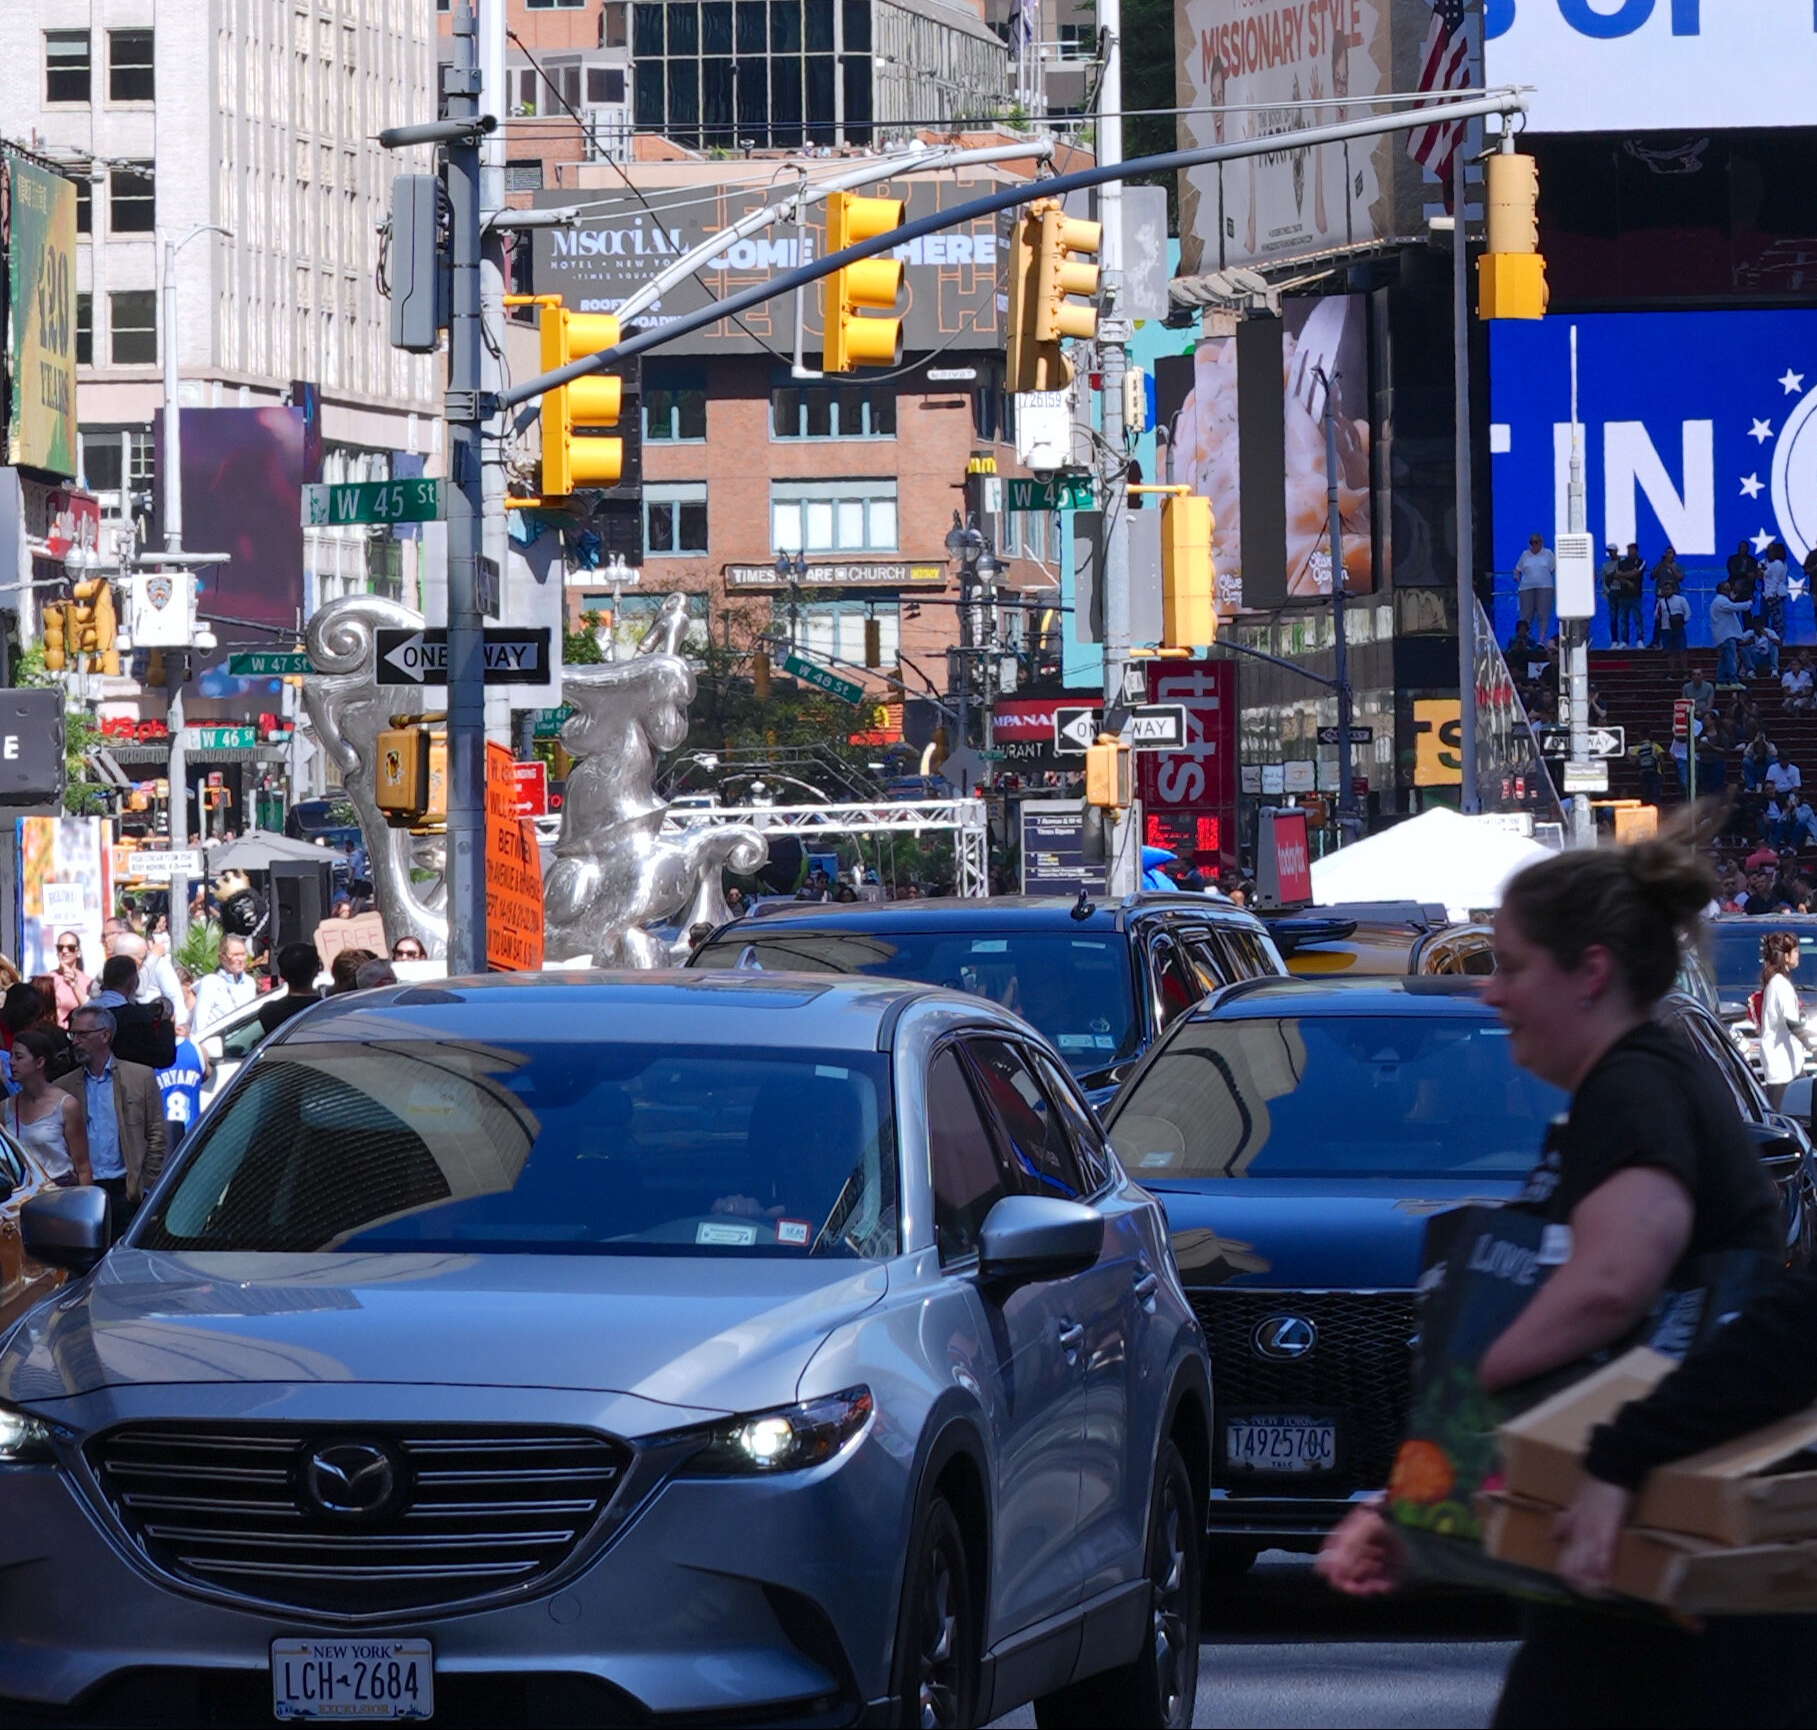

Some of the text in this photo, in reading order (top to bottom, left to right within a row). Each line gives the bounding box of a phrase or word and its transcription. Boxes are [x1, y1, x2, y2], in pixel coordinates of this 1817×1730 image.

[1201, 1, 1304, 84] MISSIONARY
[891, 233, 997, 266] HERE
[551, 259, 645, 271] HOTEL NEW
[337, 483, 436, 521] W 45 St
[1013, 483, 1032, 508] W
[1043, 481, 1069, 509] 45
[733, 567, 777, 583] TIMES
[848, 566, 906, 583] CHURCH
[251, 656, 309, 672] W 47 St
[404, 646, 448, 669] ONE
[798, 663, 811, 678] W
[832, 679, 850, 695] St
[202, 730, 216, 748] W
[222, 730, 241, 748] 46
[1076, 721, 1103, 739] ON
[1158, 670, 1219, 804] tkts
[321, 924, 385, 956] FREE
[167, 1090, 188, 1121] 8
[1232, 1427, 1331, 1458] T492570C
[313, 1645, 392, 1659] NEW YORK
[317, 1704, 390, 1715] EXCELSIOR
